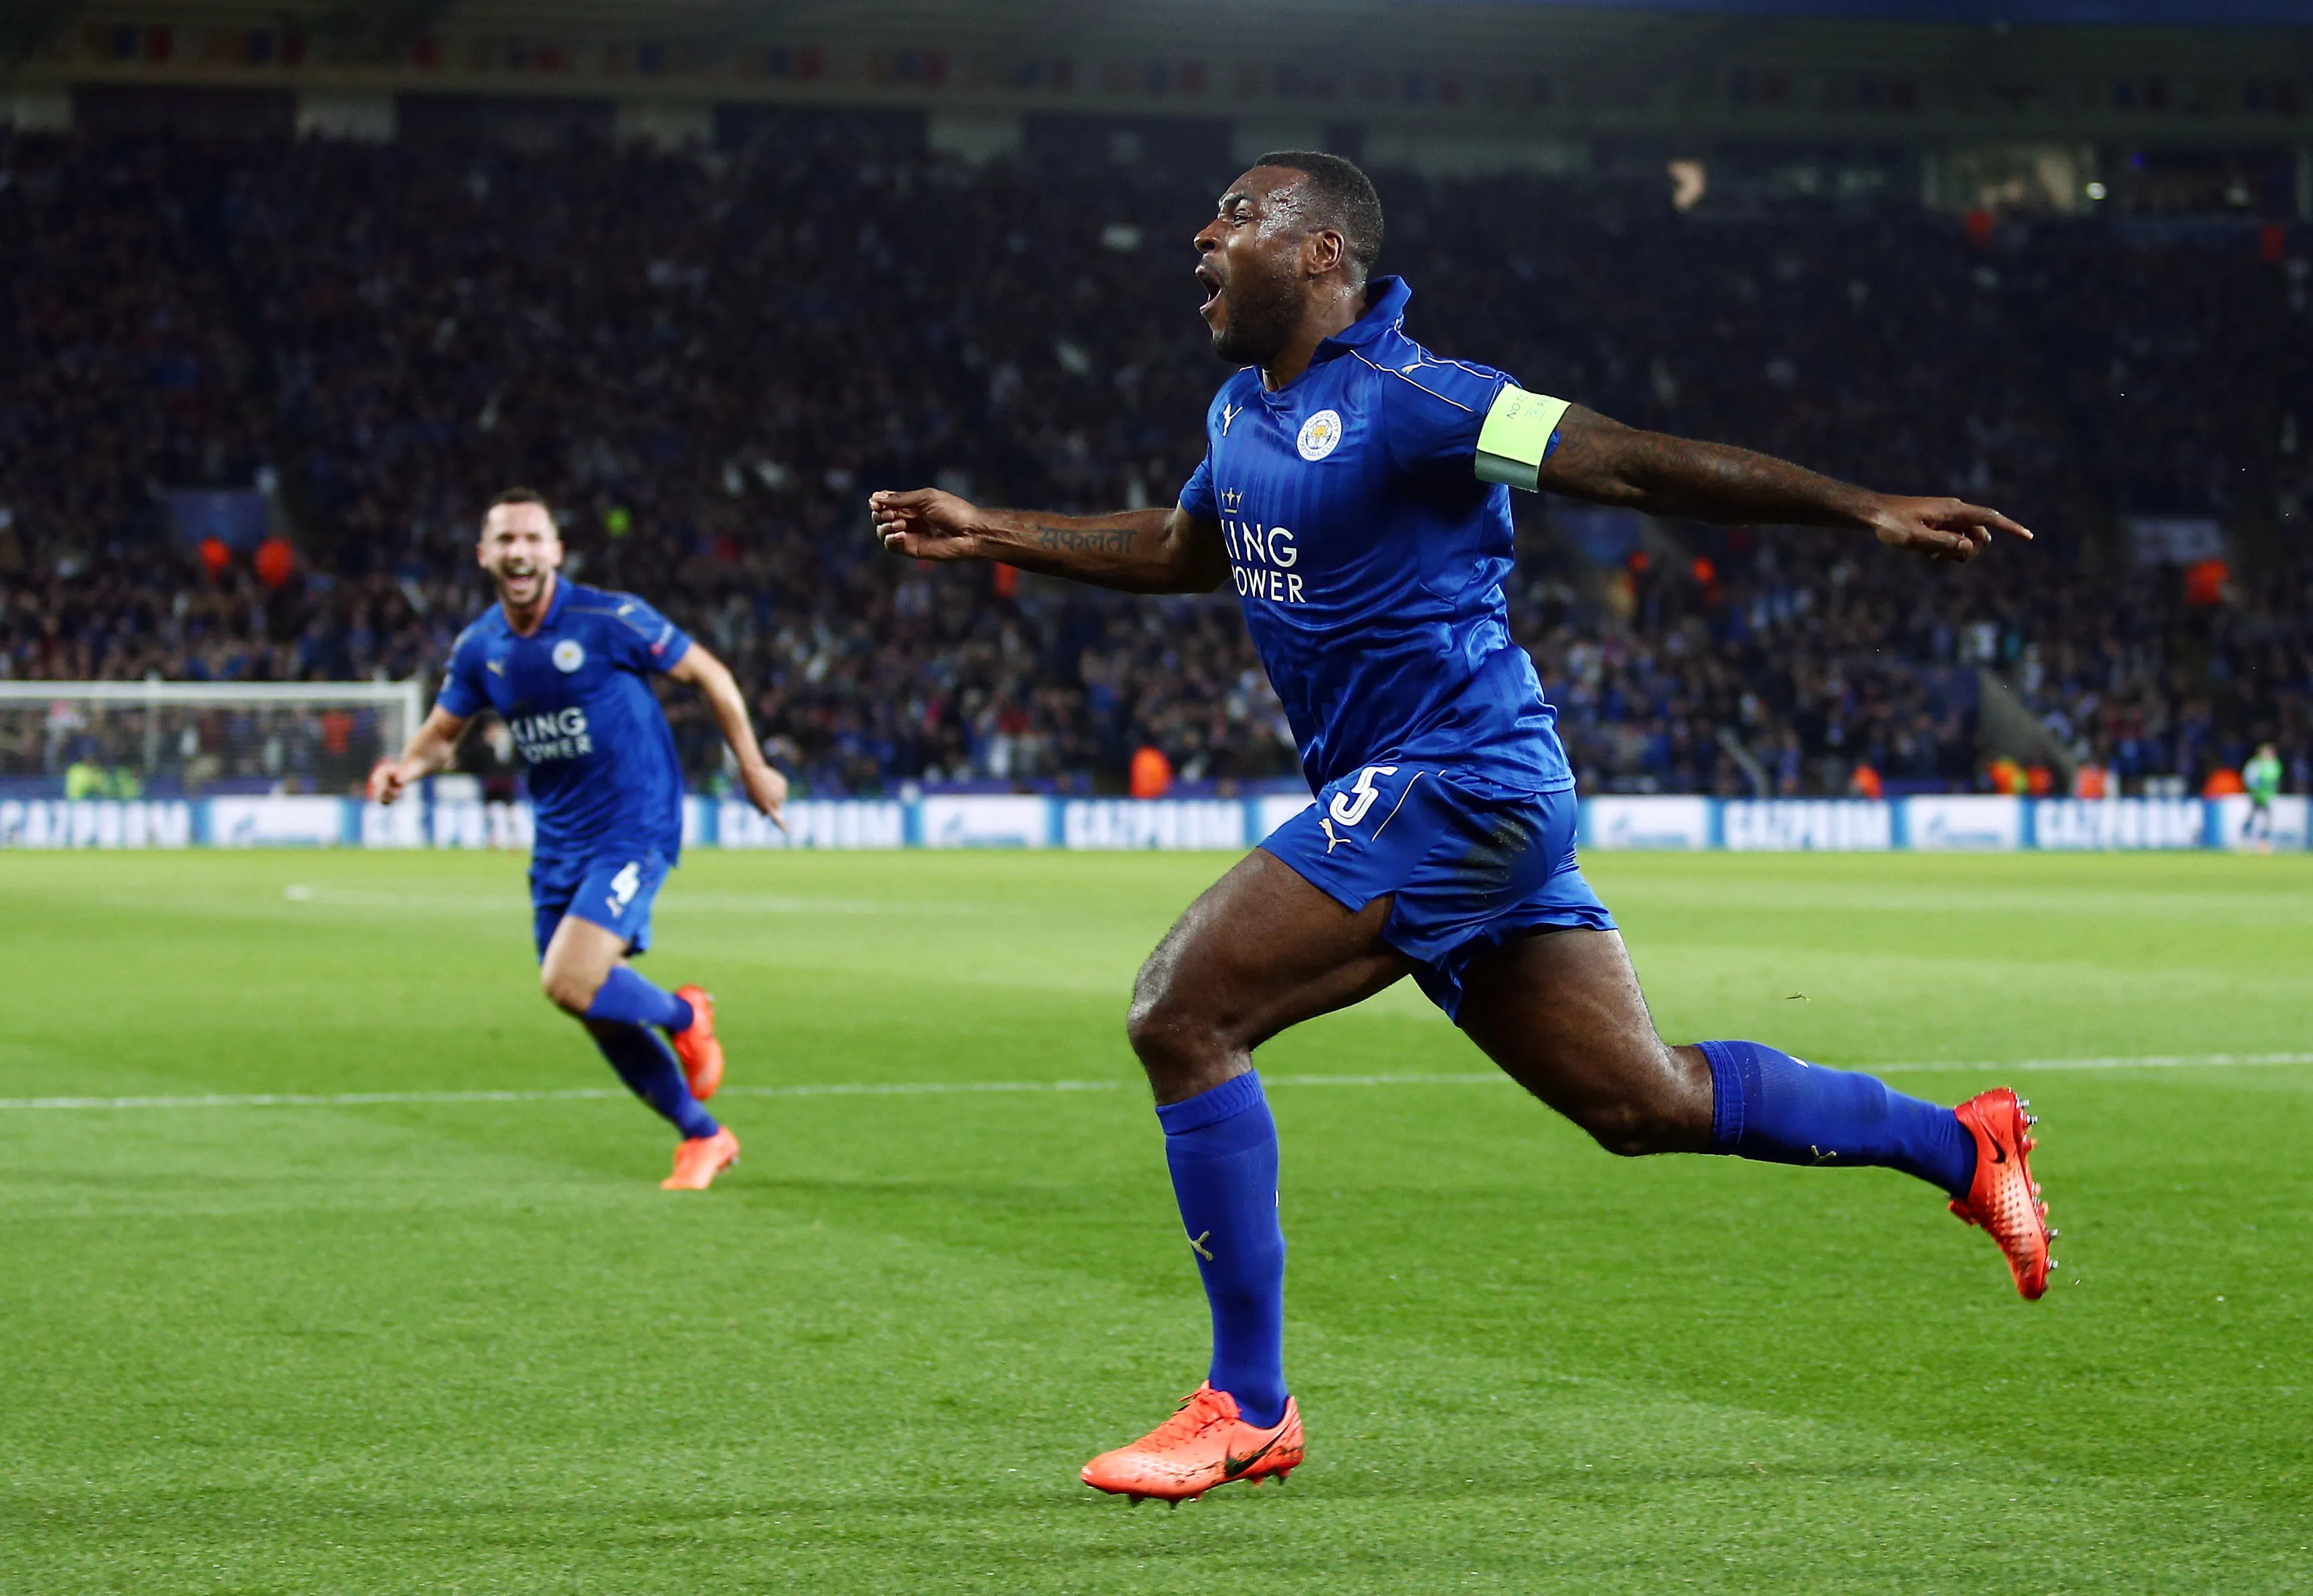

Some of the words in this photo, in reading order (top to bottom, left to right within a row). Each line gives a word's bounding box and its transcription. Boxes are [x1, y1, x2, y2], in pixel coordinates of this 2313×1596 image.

[1507, 403, 1521, 420] NO
[1037, 525, 1137, 554] सफलता
[1231, 565, 1306, 603] OWER
[519, 734, 594, 764] OWER
[1330, 766, 1399, 826] 5
[610, 860, 640, 905] 4
